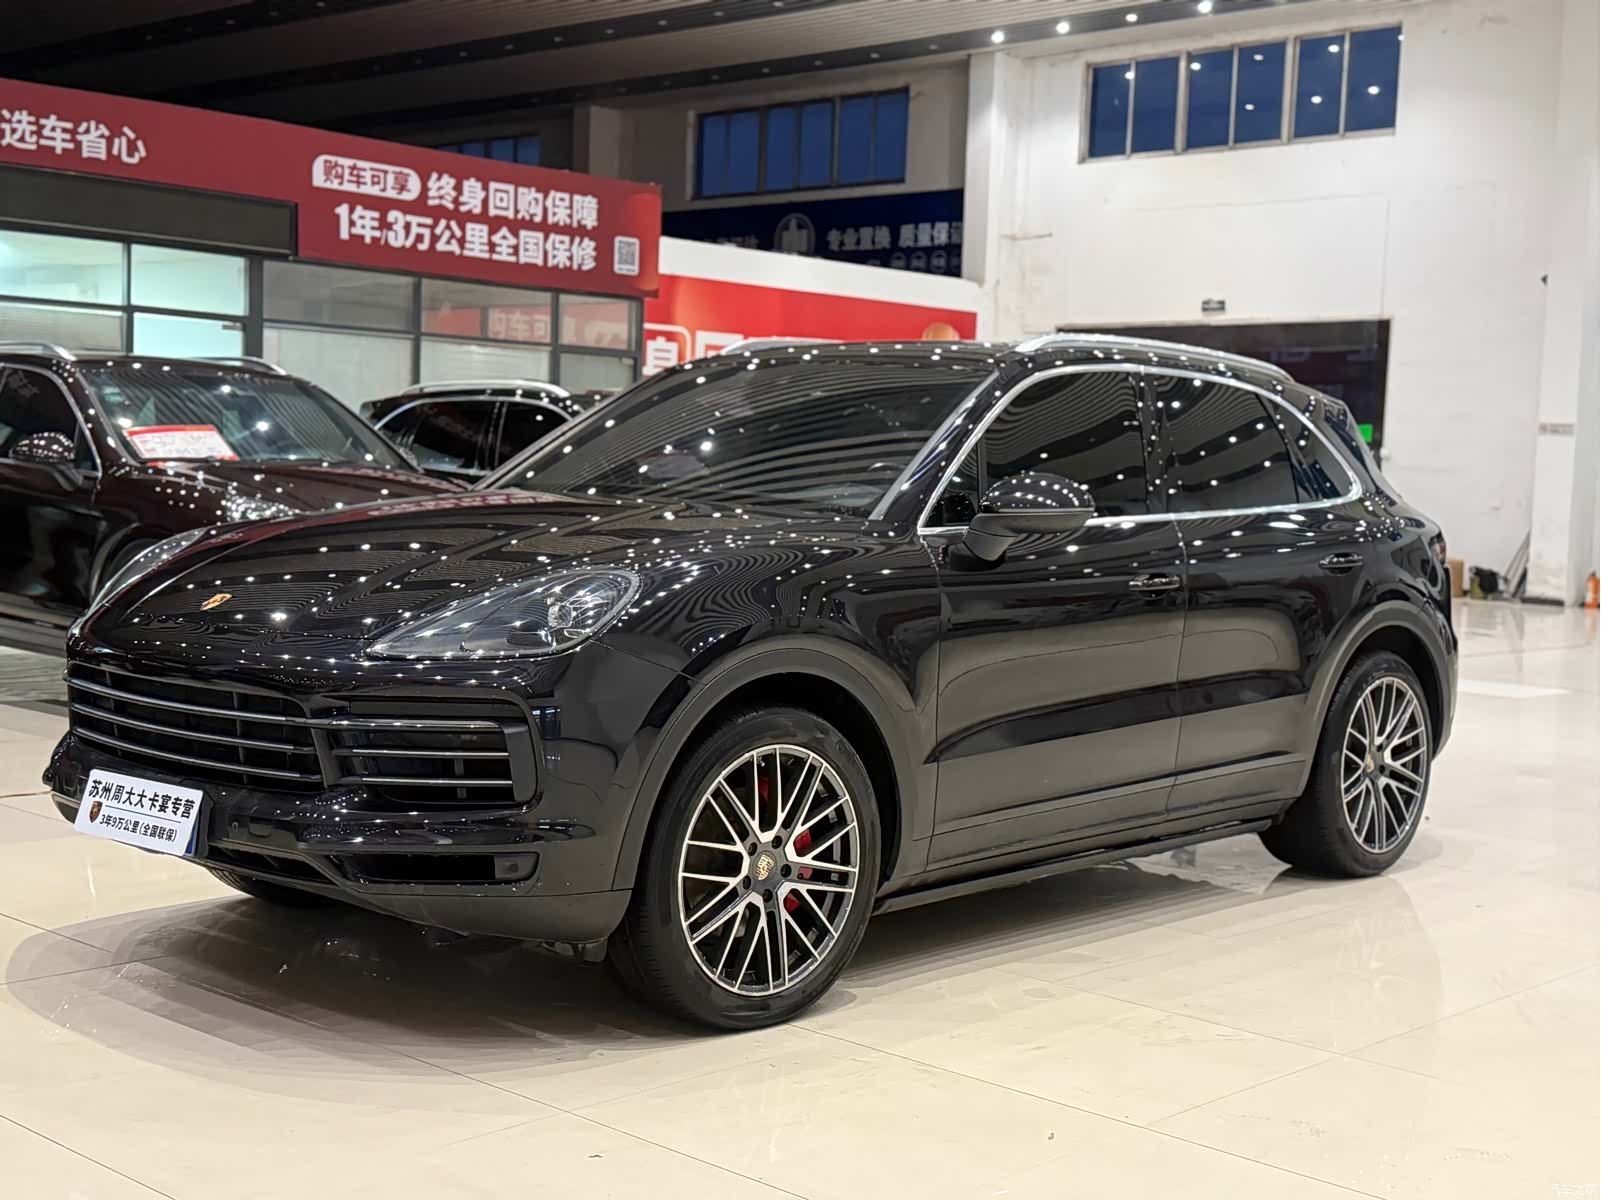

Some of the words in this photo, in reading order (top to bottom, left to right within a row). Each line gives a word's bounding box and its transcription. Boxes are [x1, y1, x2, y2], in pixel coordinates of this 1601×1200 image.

[0, 108, 147, 163] 选车省心
[322, 159, 412, 196] 购车可享
[428, 172, 599, 229] 终身回购保障
[88, 779, 196, 818] 苏州周大大卡宴专营
[99, 815, 178, 842] 3年9万公里(全国联保)
